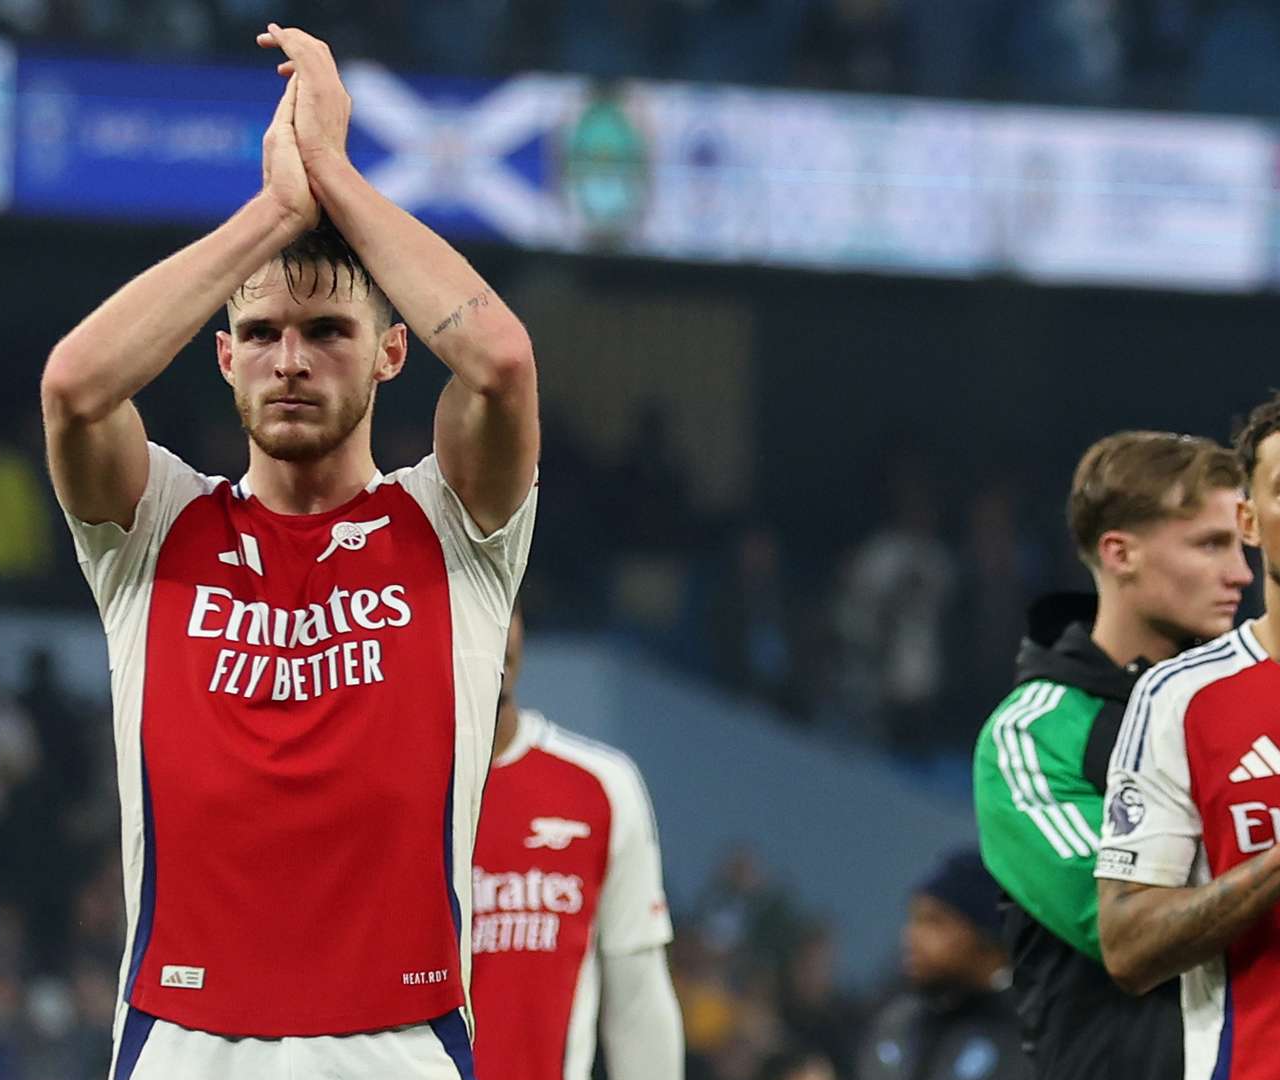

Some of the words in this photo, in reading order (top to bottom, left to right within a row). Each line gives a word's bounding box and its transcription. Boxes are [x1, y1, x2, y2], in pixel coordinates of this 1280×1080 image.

[187, 584, 412, 649] Emirates
[208, 648, 270, 698] FLY
[272, 639, 385, 701] BETTER
[472, 865, 584, 914] irates
[402, 969, 448, 985] HEAT.RDY
